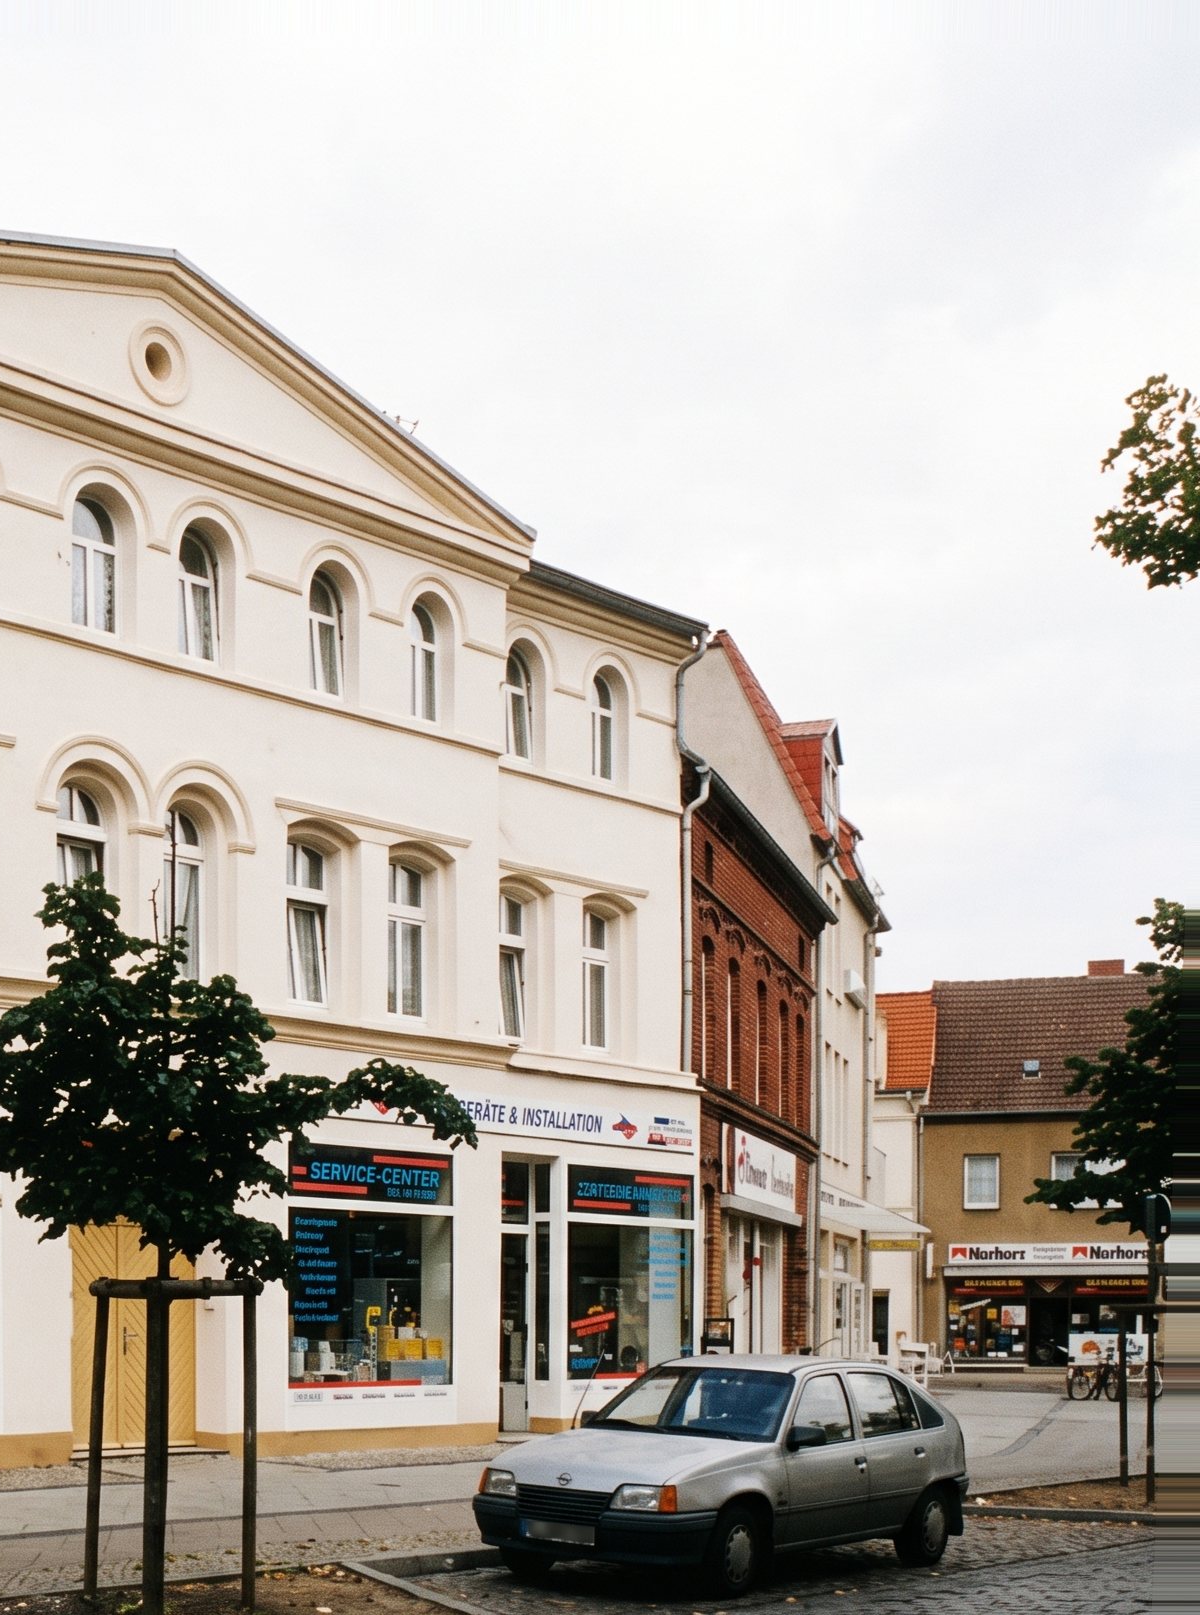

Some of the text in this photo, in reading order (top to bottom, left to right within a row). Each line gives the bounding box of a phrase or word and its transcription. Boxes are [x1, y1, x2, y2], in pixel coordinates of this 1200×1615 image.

[509, 1111, 518, 1125] &
[522, 1107, 603, 1133] INSTALLATION
[310, 1161, 440, 1188] SERVICE-CENTER
